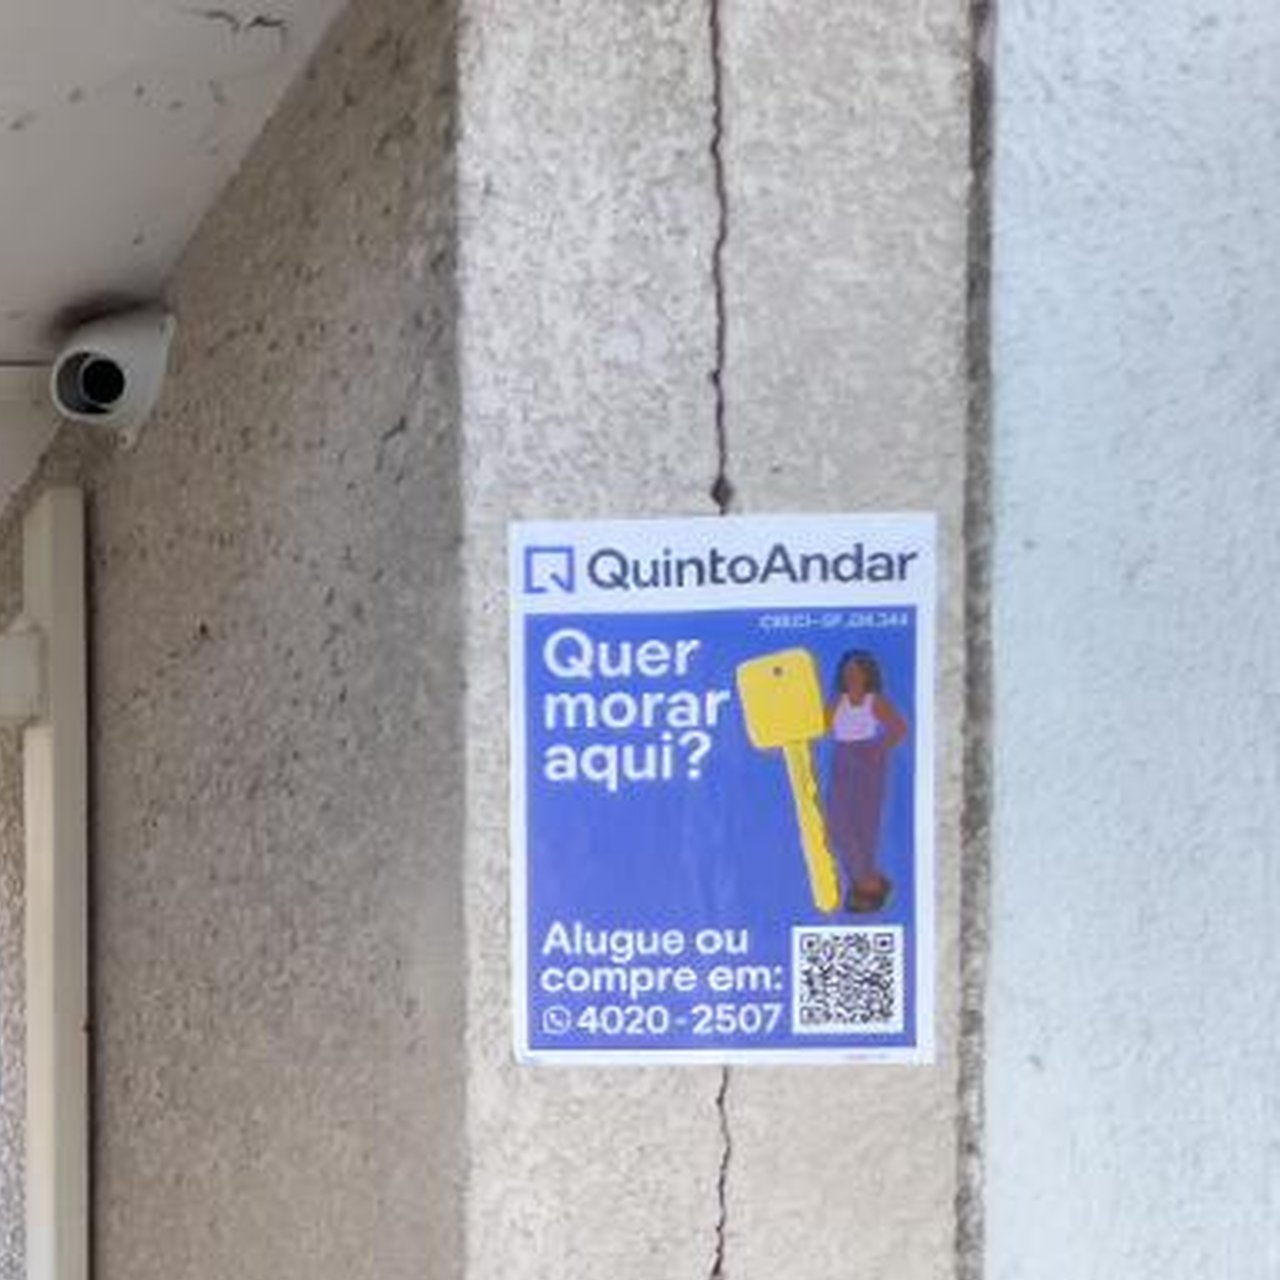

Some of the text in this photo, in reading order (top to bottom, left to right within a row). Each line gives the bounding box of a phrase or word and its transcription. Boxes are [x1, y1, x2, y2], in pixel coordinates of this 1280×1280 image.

[587, 543, 918, 590] QuintoAndar
[543, 628, 701, 679] Quer
[544, 688, 731, 730] morar
[544, 730, 712, 792] aqui?
[543, 921, 749, 963] Alugue ou
[541, 964, 784, 1000] compre em:
